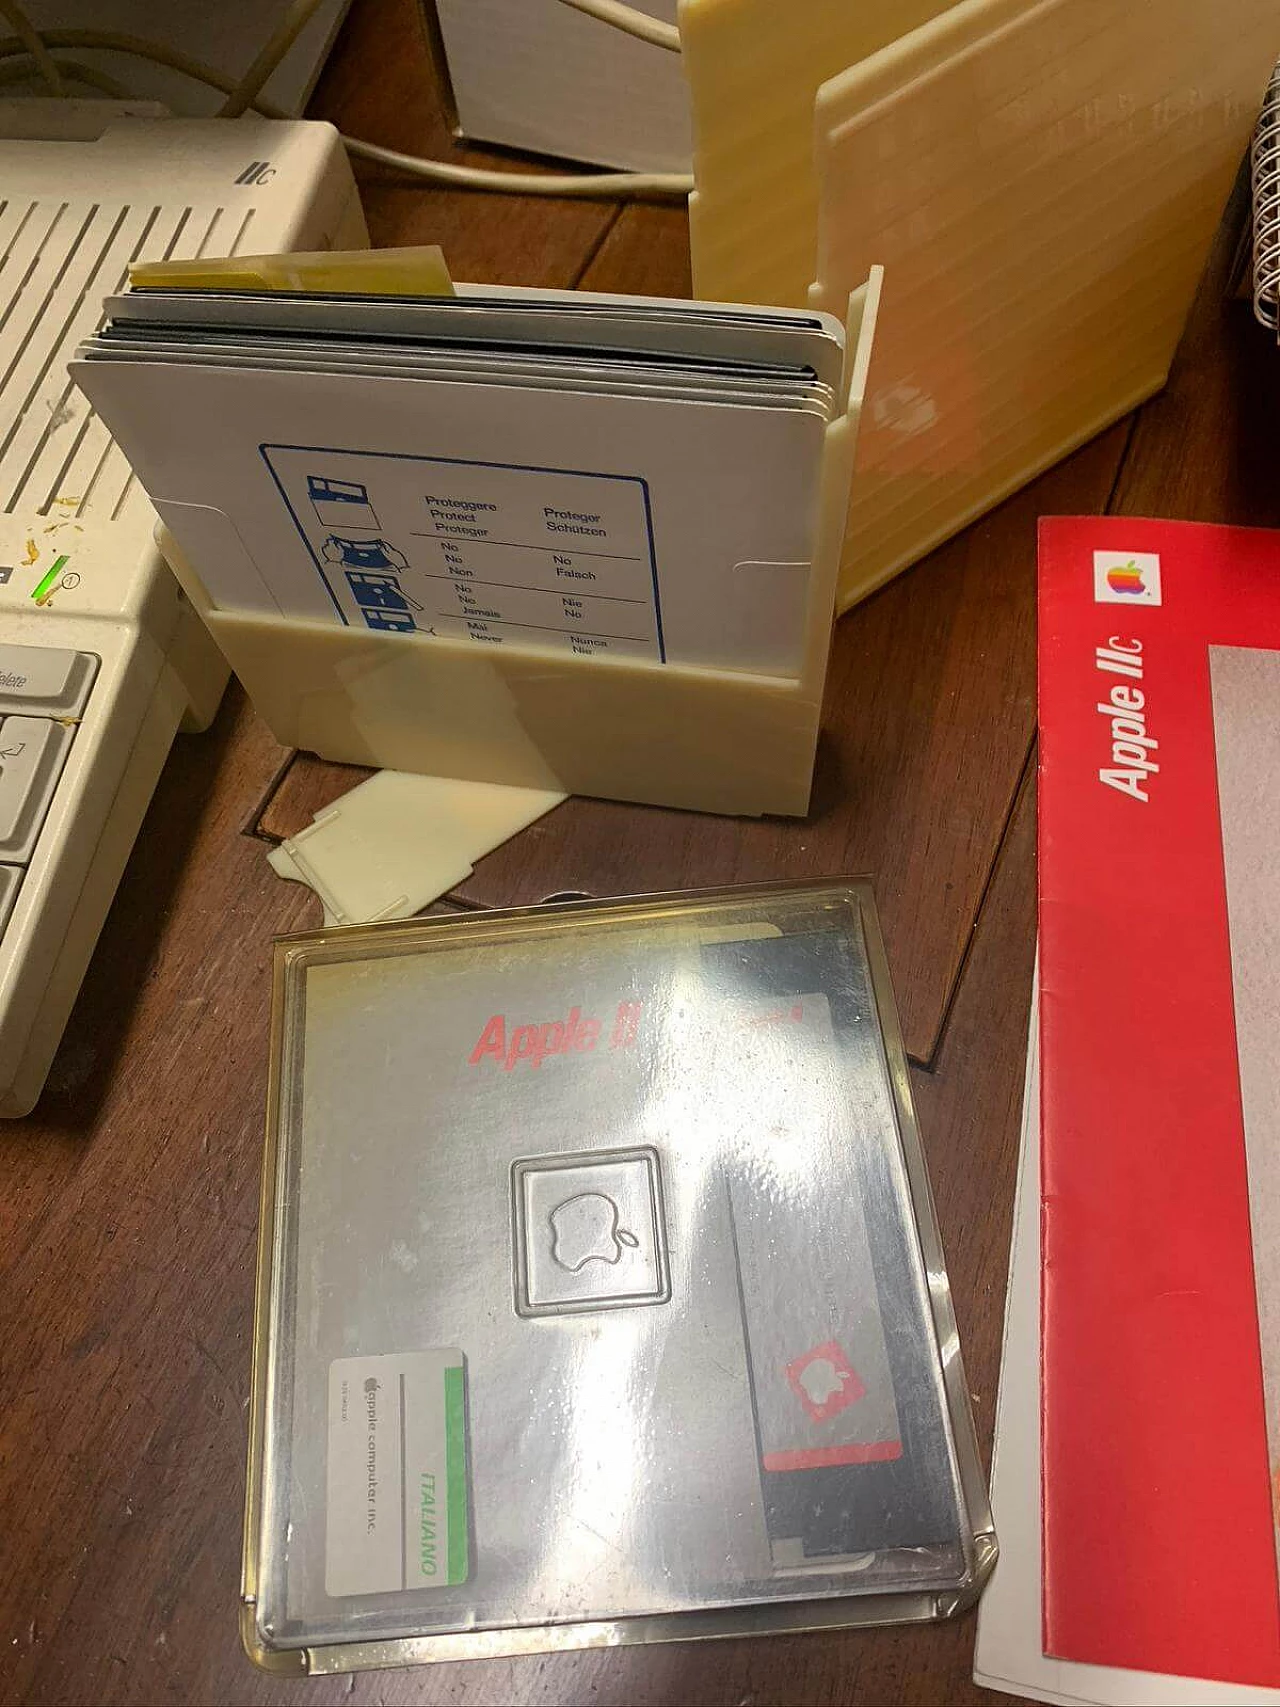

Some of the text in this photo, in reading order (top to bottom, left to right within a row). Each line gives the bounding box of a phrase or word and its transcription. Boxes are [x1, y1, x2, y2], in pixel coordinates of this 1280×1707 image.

[425, 495, 497, 512] Proteggere
[430, 508, 476, 522] Protect
[544, 507, 601, 524] Proteger
[435, 522, 488, 538] Proteger
[546, 521, 607, 537] Schützen
[441, 542, 459, 552] No
[445, 554, 463, 564] No
[553, 555, 572, 566] No
[449, 566, 473, 577] Non
[556, 567, 596, 580] Falsch
[454, 584, 472, 594] No
[458, 595, 476, 605] No
[562, 598, 583, 608] Nie
[463, 606, 501, 619] Jamais
[564, 609, 582, 619] No
[470, 632, 504, 644] Never
[570, 636, 608, 648] Nunca
[0, 670, 27, 688] elete
[1097, 684, 1160, 803] Apple
[467, 1006, 602, 1072] Apple
[366, 1392, 378, 1431] apple
[366, 1434, 377, 1506] computer
[420, 1472, 438, 1577] ITALIANO
